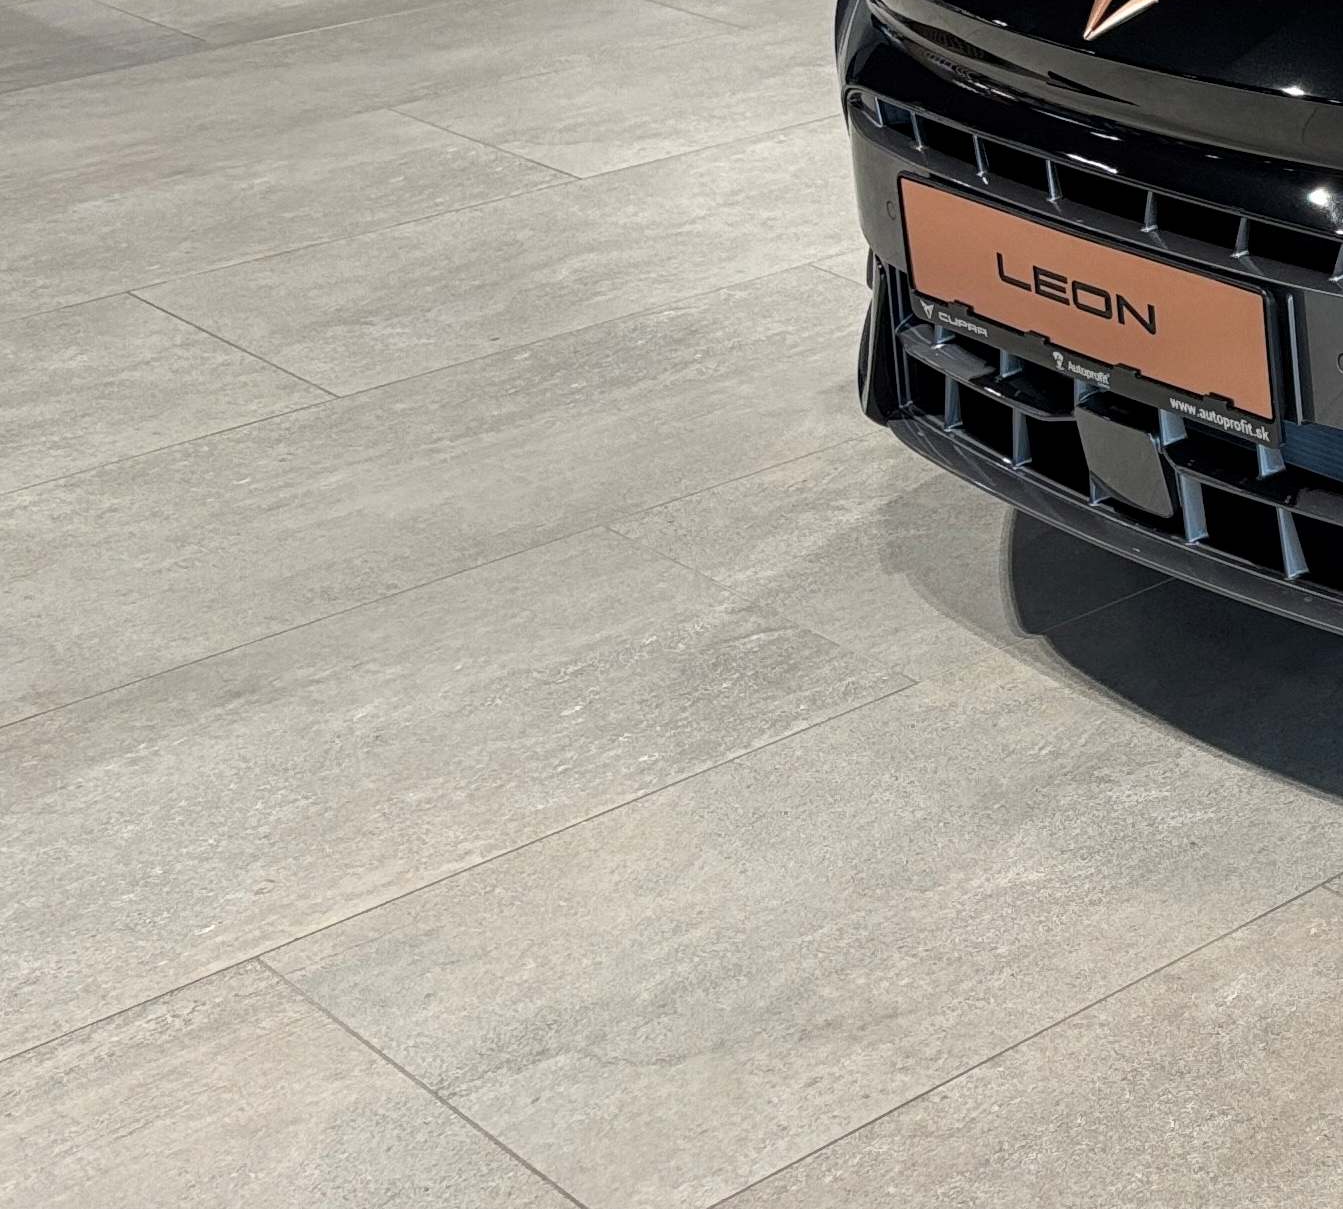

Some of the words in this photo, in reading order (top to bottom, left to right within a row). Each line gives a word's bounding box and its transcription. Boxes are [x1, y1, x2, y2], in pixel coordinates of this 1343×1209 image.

[996, 251, 1157, 335] LEON
[938, 311, 989, 338] CUPRA
[1067, 360, 1110, 385] Autoprofit
[1169, 396, 1271, 443] www.autoprofit.sk
